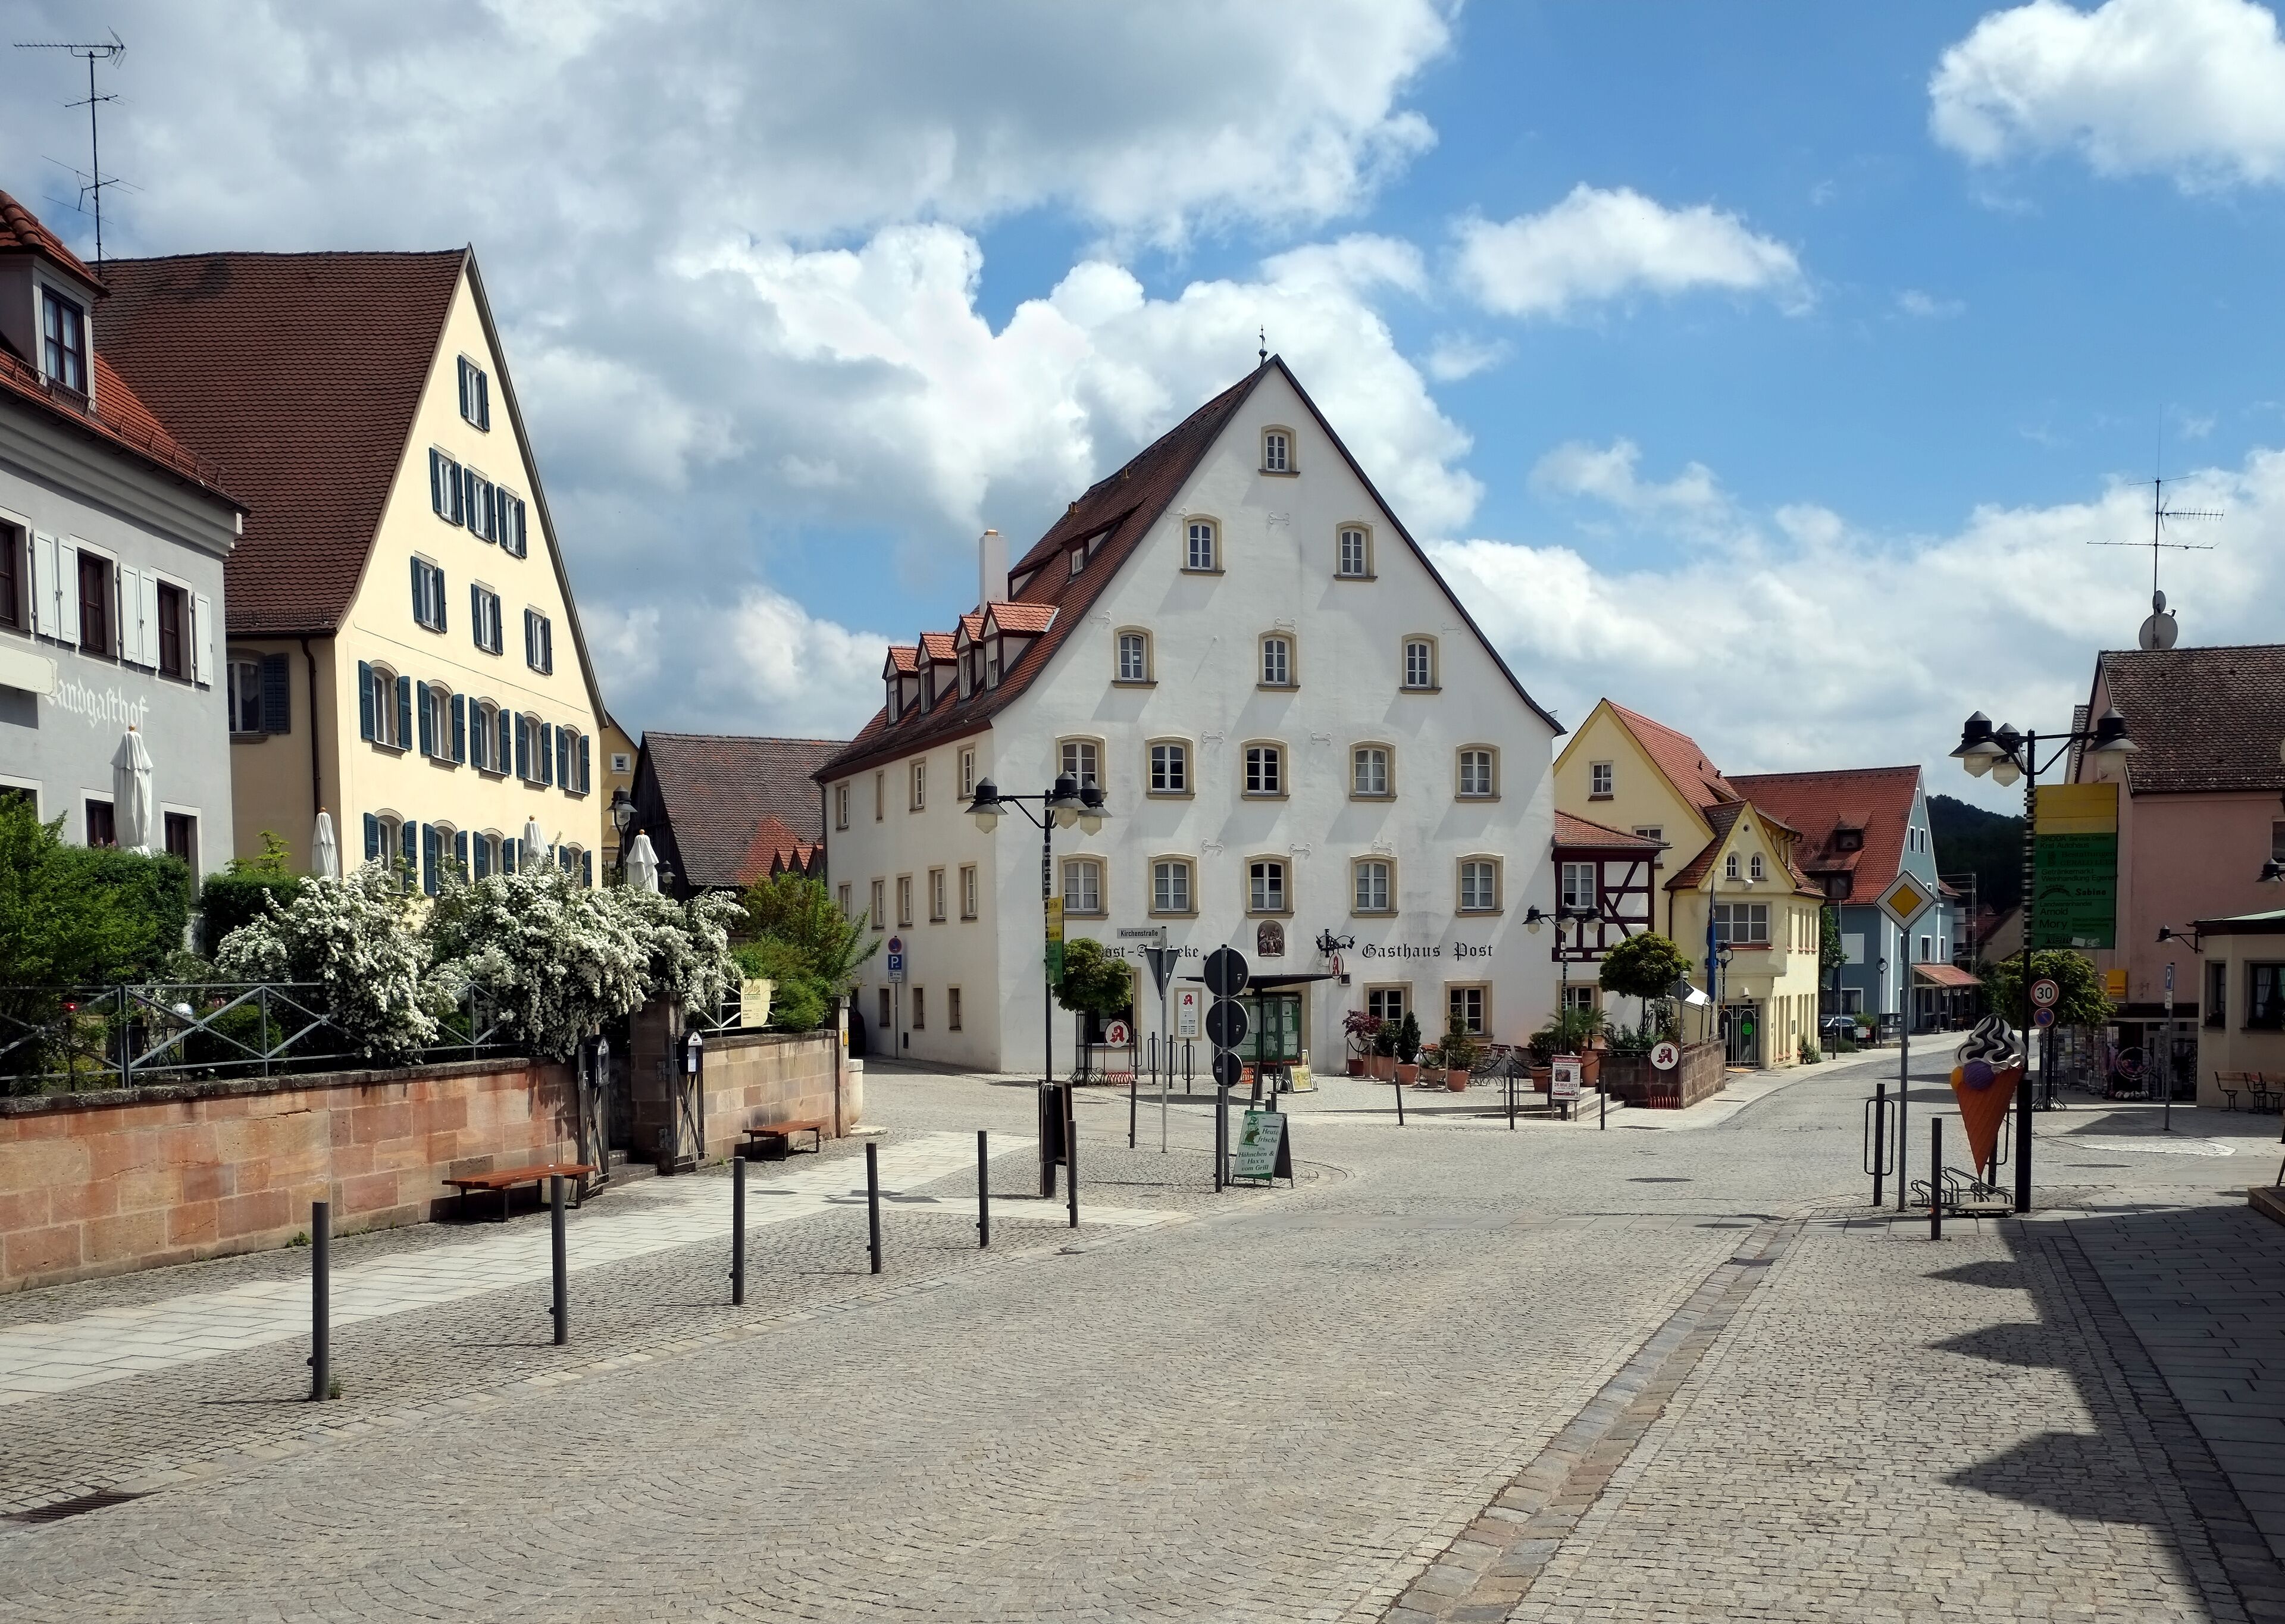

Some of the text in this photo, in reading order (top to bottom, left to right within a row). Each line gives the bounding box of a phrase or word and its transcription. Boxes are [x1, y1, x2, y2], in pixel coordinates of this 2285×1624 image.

[2039, 919, 2067, 930] Mory
[1362, 941, 1493, 962] Gasthaus Post
[891, 956, 899, 968] P
[2167, 968, 2171, 986] P
[2037, 987, 2052, 999] 30
